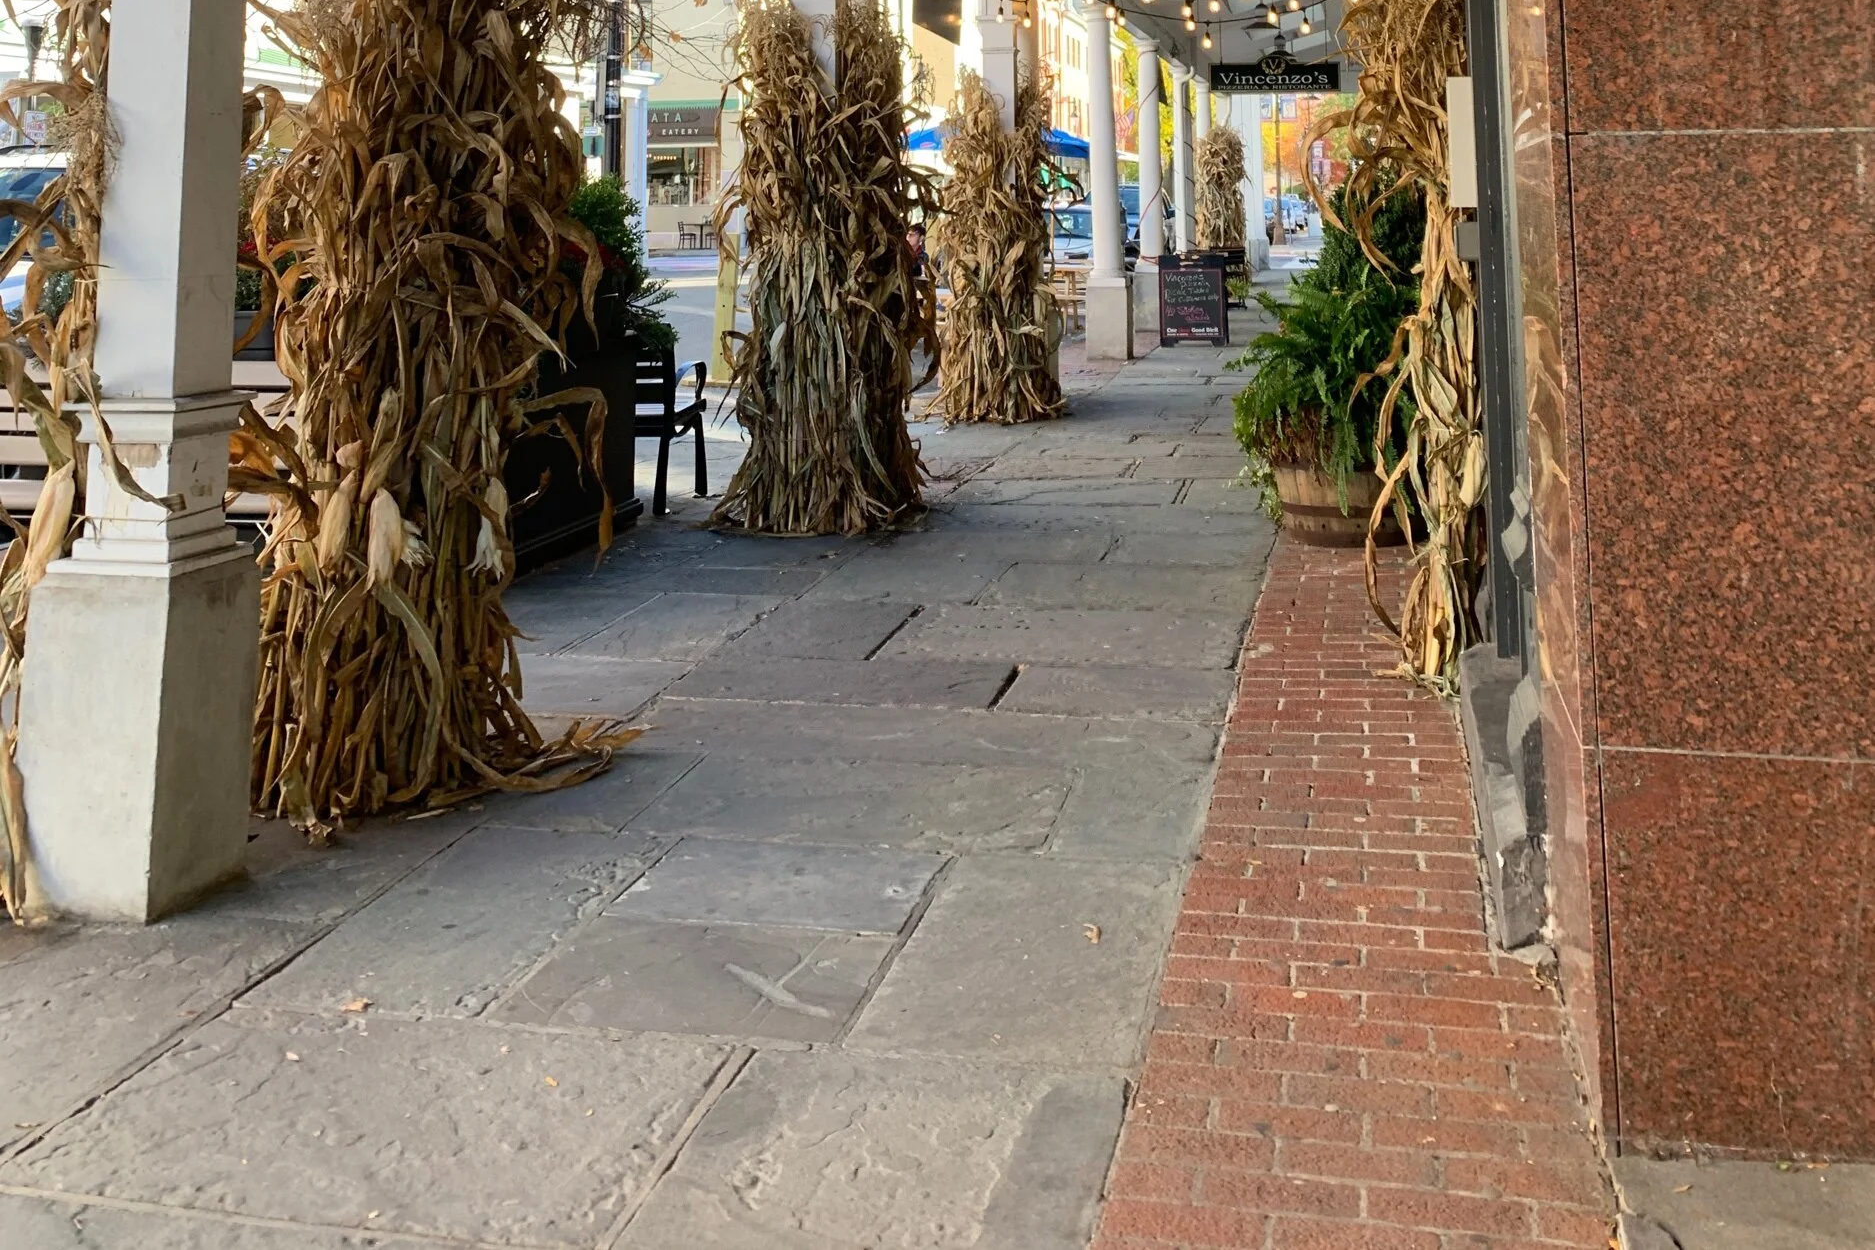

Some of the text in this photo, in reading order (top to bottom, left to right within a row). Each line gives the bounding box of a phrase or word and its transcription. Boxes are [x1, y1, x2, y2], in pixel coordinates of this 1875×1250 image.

[1269, 59, 1279, 70] V
[1219, 71, 1329, 85] Vincenzo's
[661, 128, 699, 136] EATERY
